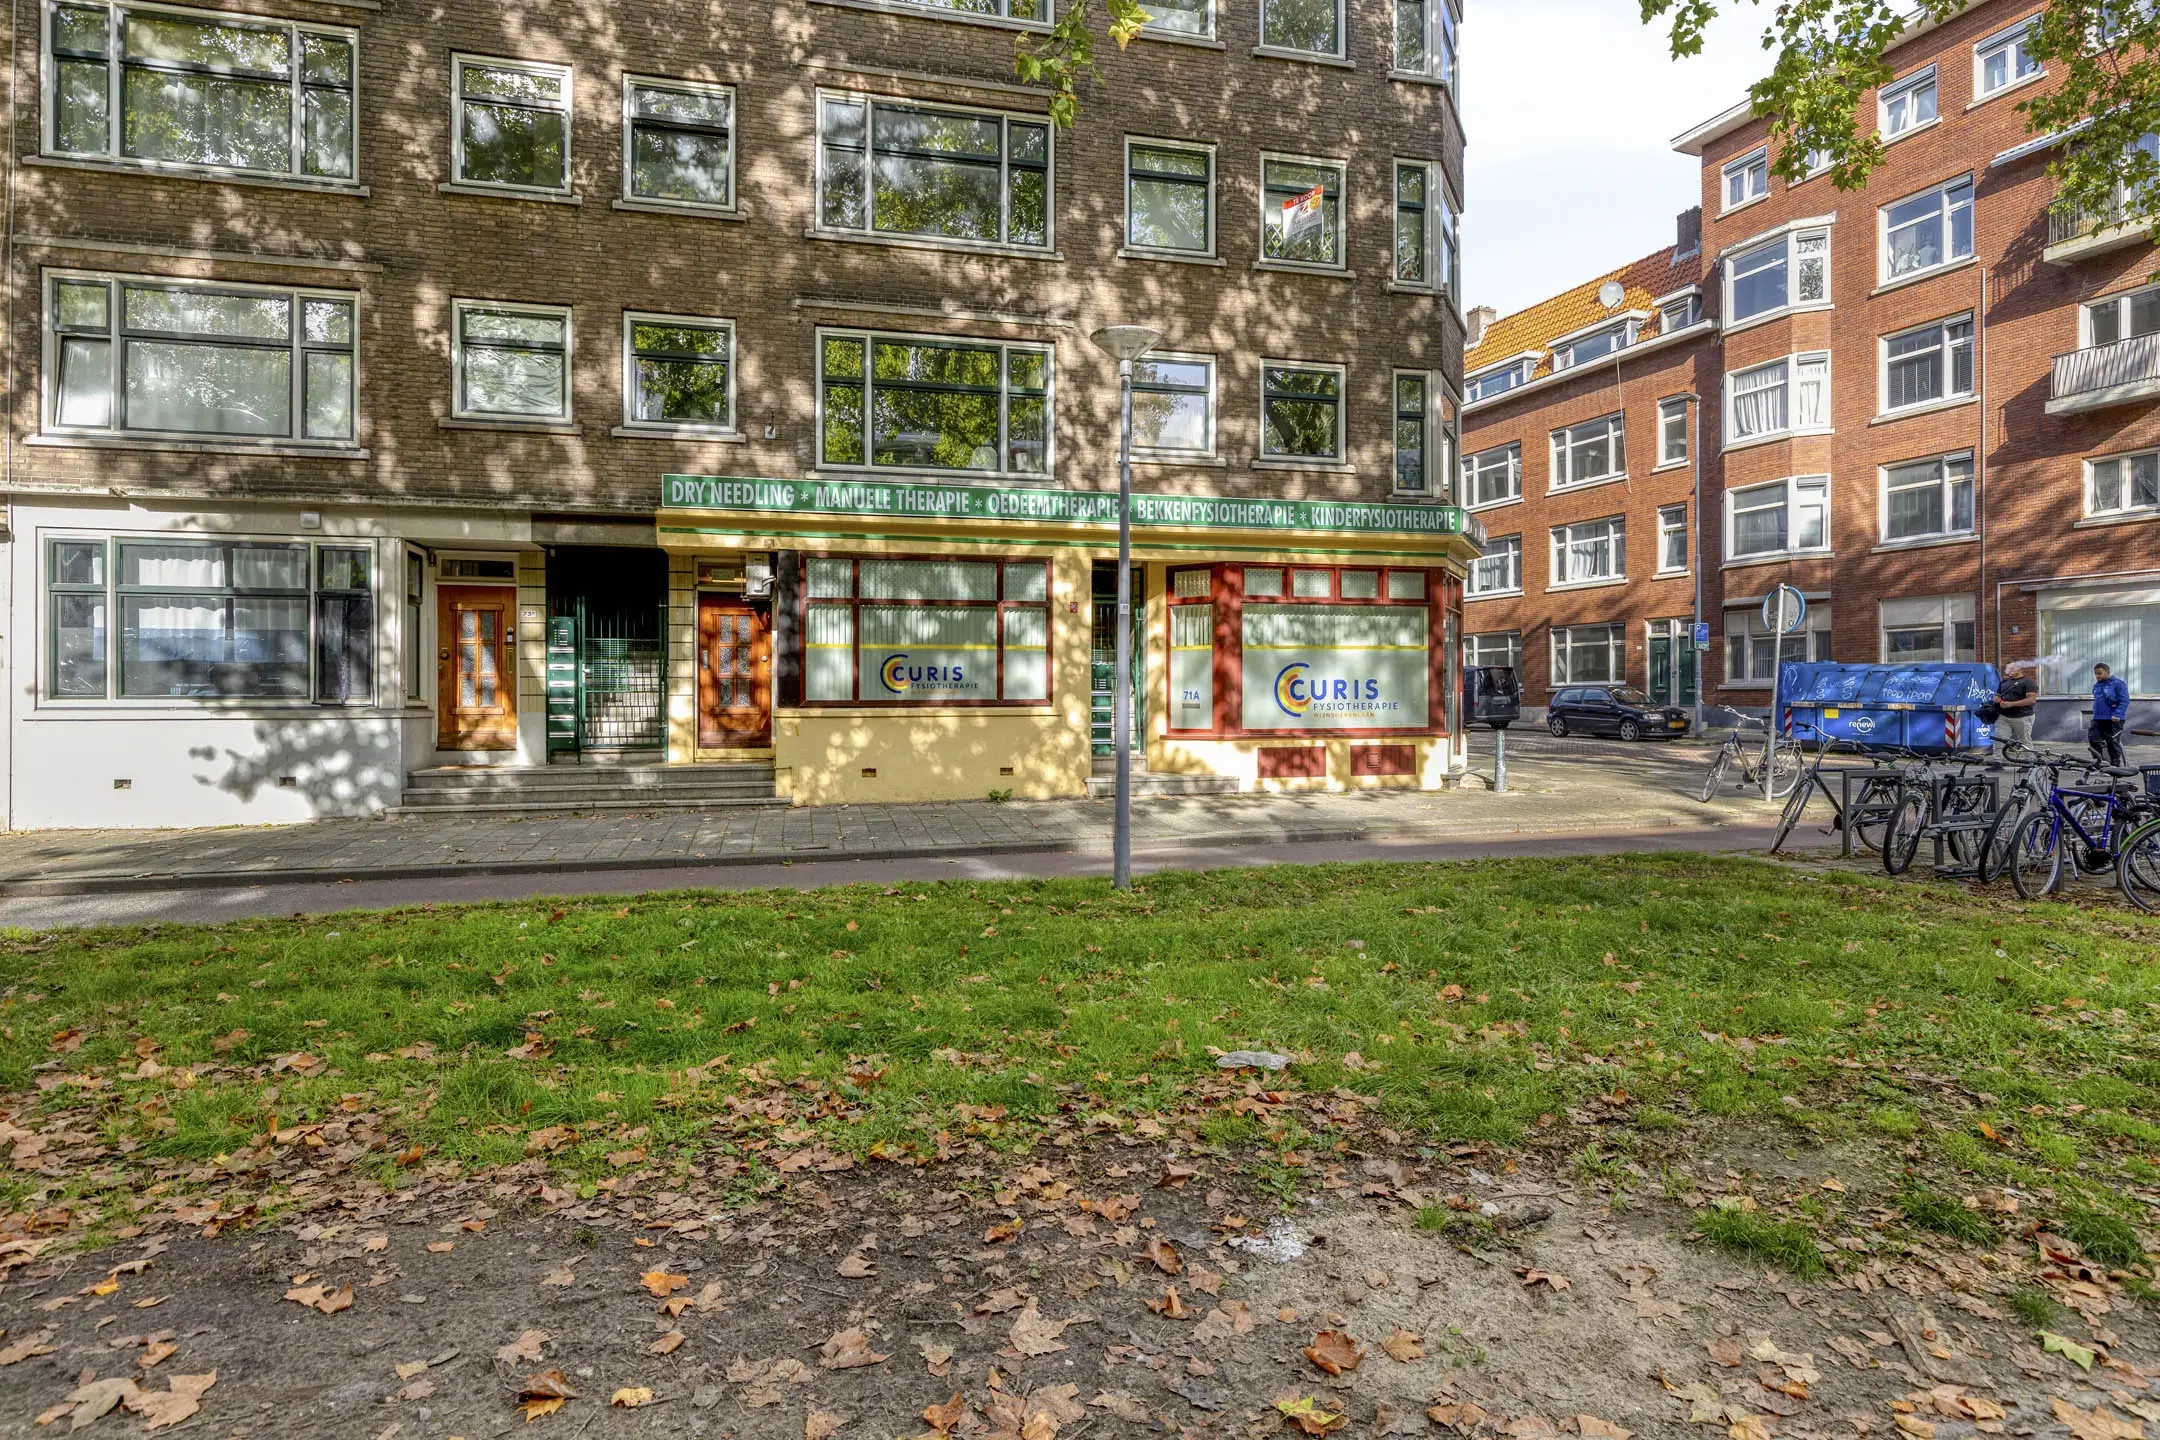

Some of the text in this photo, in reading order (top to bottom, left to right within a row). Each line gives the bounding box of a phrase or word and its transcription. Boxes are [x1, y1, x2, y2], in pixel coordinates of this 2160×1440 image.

[671, 480, 1455, 531] DRY NEEDLING MANUELE THERAPIE OEDEEMTHERAPIE BEKKENFYSIOTHERAPIE KINDERFYSIOTHERAPIE
[892, 666, 964, 682] CURIS
[1184, 690, 1200, 701] 71A
[1290, 678, 1380, 700] CURIS
[1313, 702, 1399, 711] FYSIOTHERAPIE
